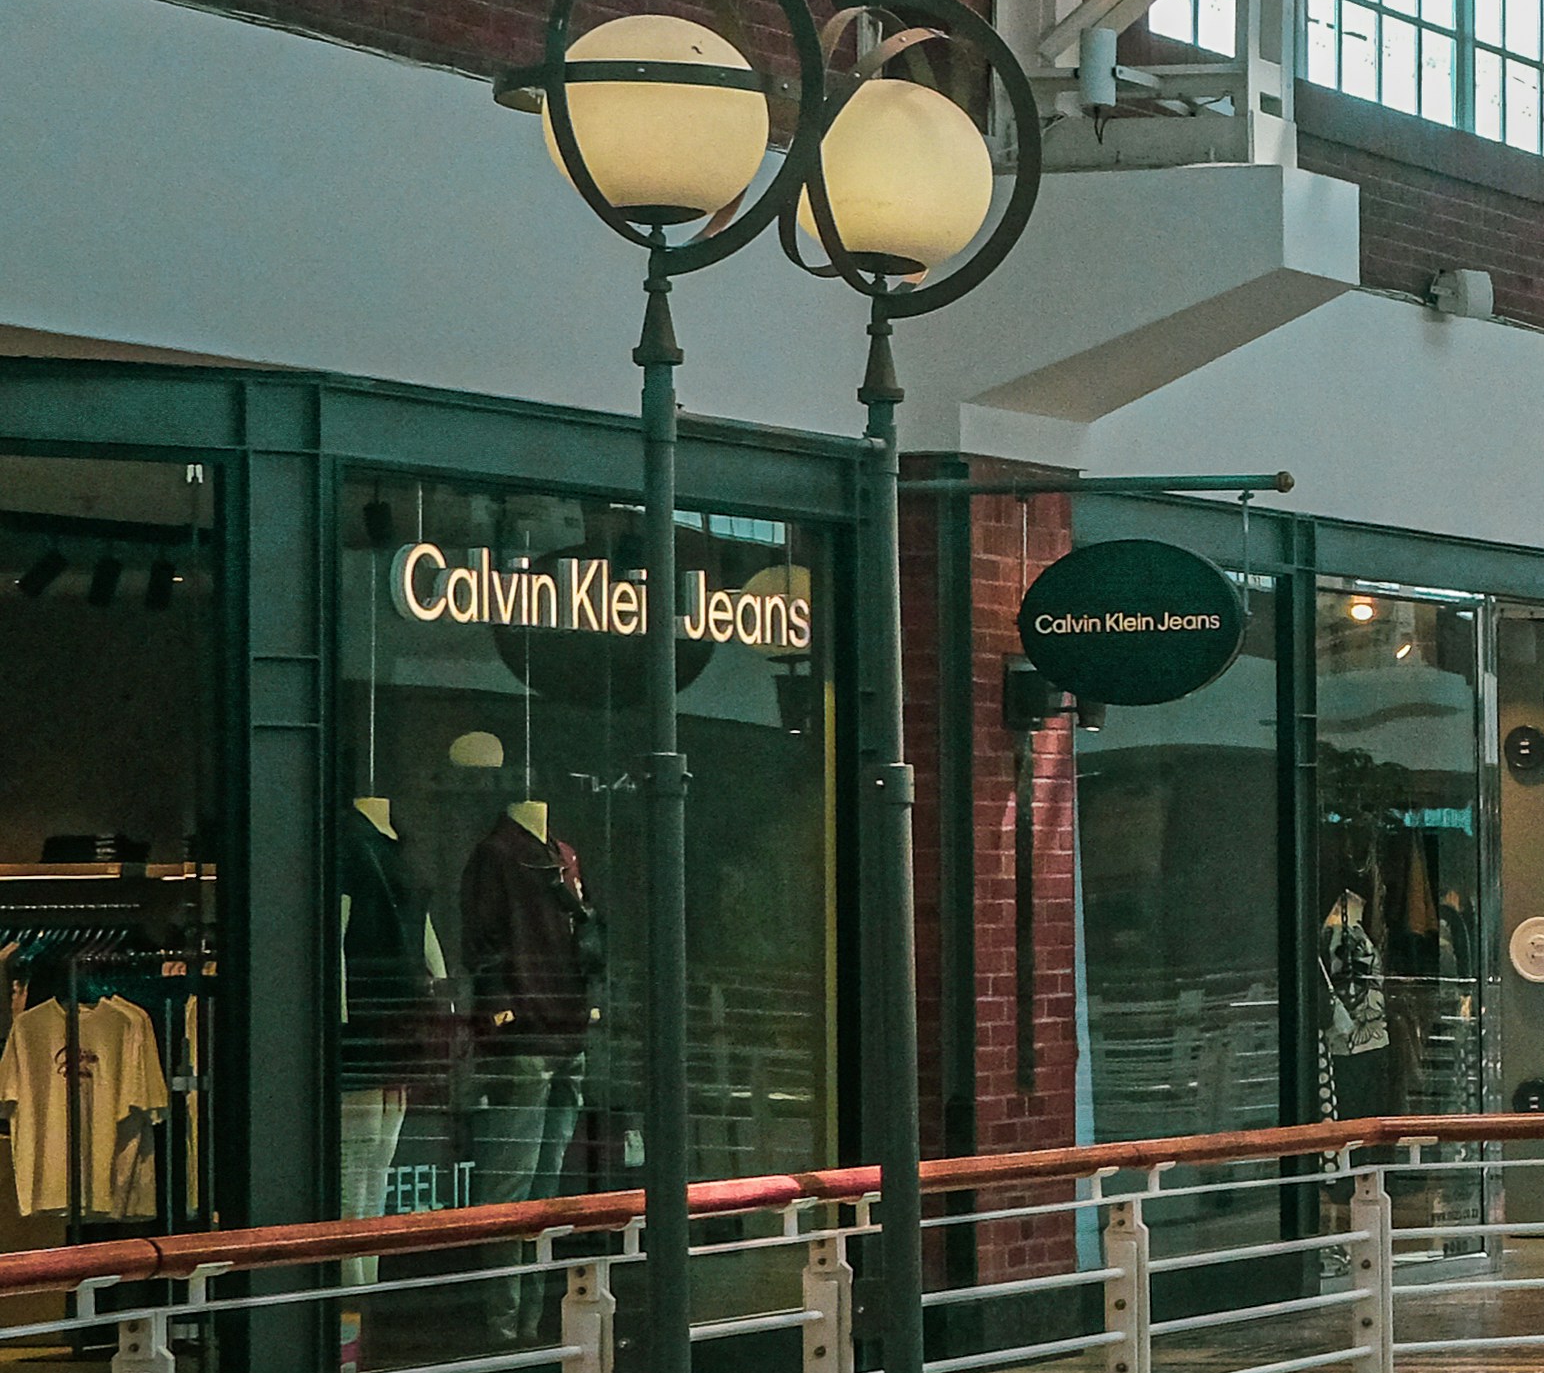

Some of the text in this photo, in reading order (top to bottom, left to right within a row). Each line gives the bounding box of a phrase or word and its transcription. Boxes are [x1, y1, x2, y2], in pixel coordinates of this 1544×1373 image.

[402, 542, 812, 648] Calvin Klei Jeans
[1034, 611, 1220, 634] Calvin Klein Jeans
[454, 1161, 476, 1209] IT
